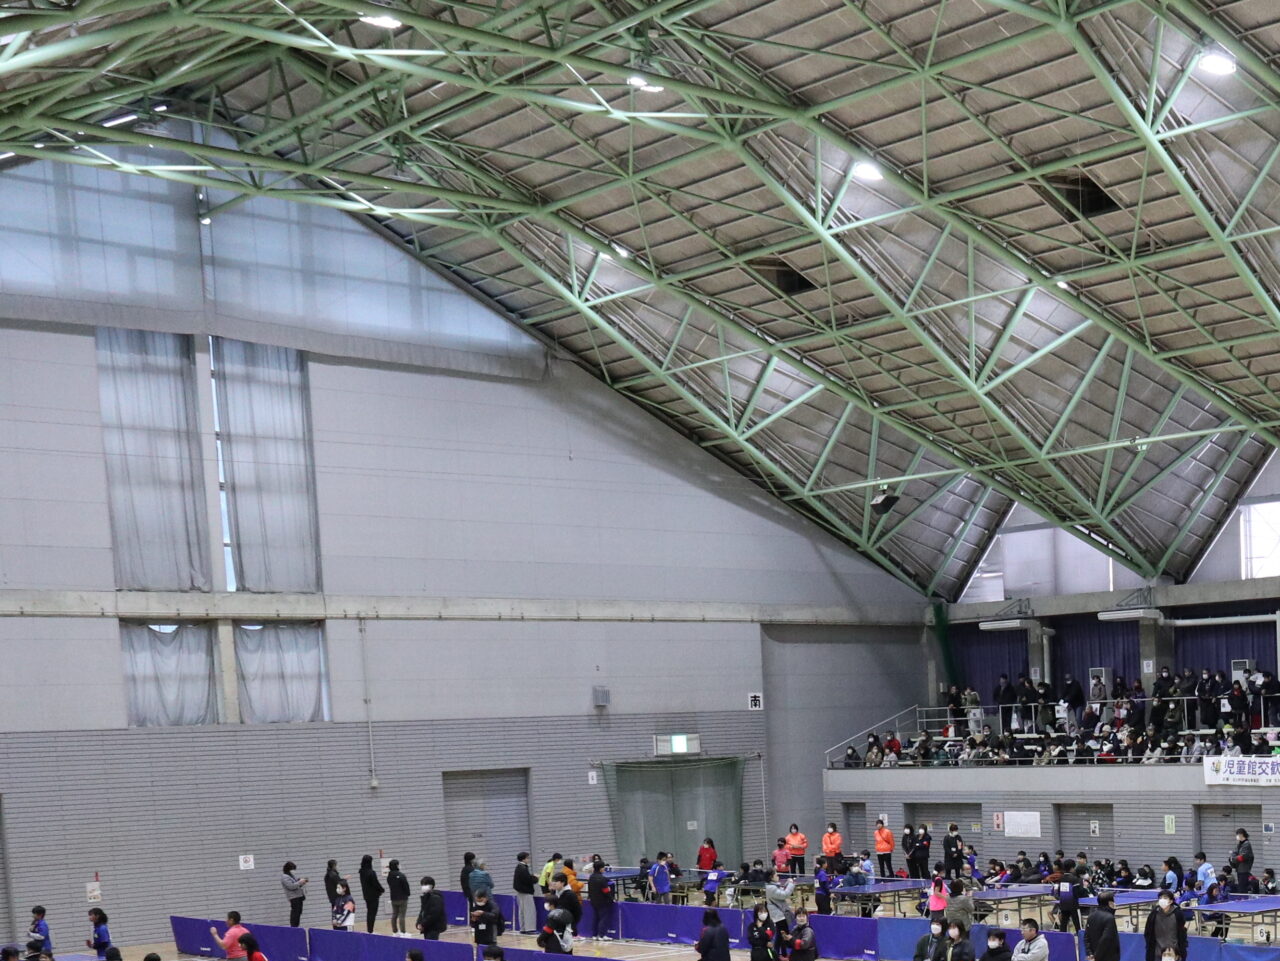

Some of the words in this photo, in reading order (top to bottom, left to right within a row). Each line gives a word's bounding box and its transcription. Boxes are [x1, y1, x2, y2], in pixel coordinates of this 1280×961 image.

[750, 694, 761, 709] 南
[1004, 913, 1009, 922] 8
[1125, 920, 1130, 929] 7
[1259, 928, 1265, 938] 6
